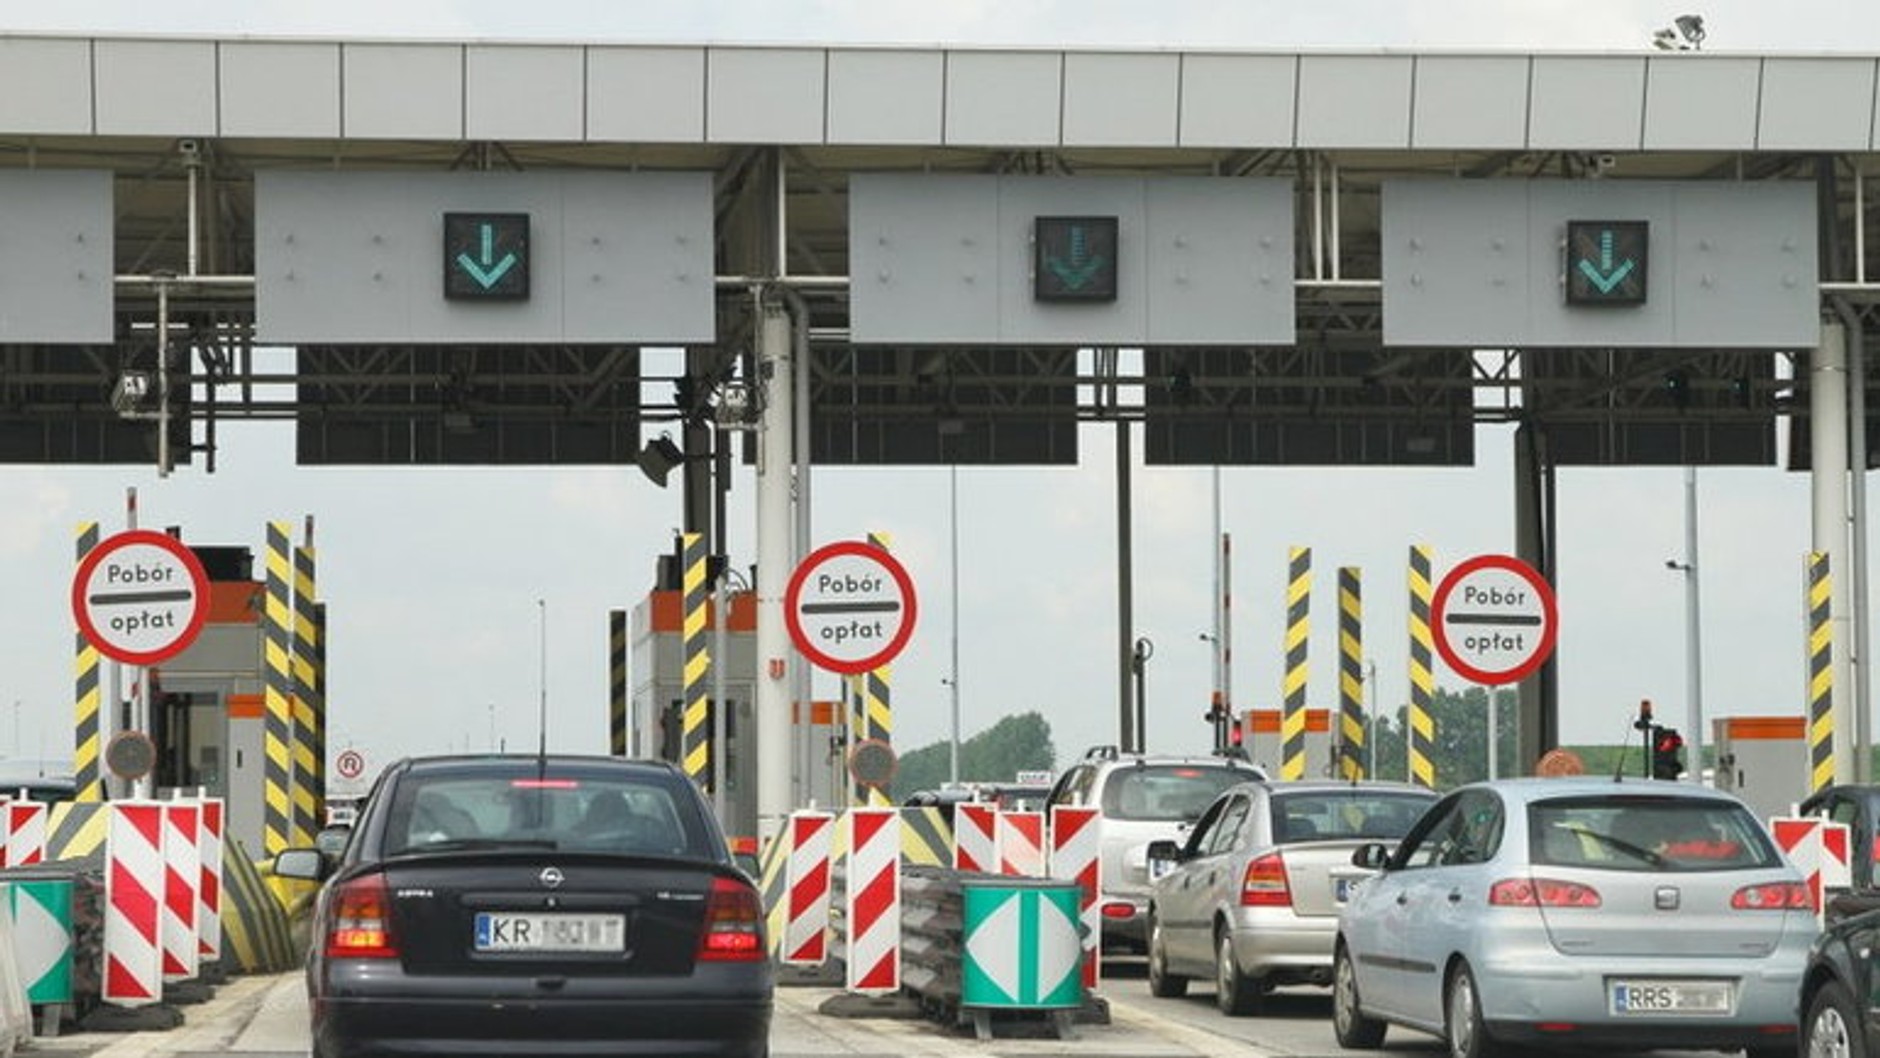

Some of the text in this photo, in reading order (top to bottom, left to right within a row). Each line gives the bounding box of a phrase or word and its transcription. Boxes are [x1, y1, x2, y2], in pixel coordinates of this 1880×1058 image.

[819, 573, 882, 593] Pobór
[1465, 585, 1525, 605] Pobór
[110, 611, 174, 635] opłat
[821, 621, 882, 644] opłat
[1464, 633, 1523, 655] opłat
[1629, 986, 1672, 1009] RRS
